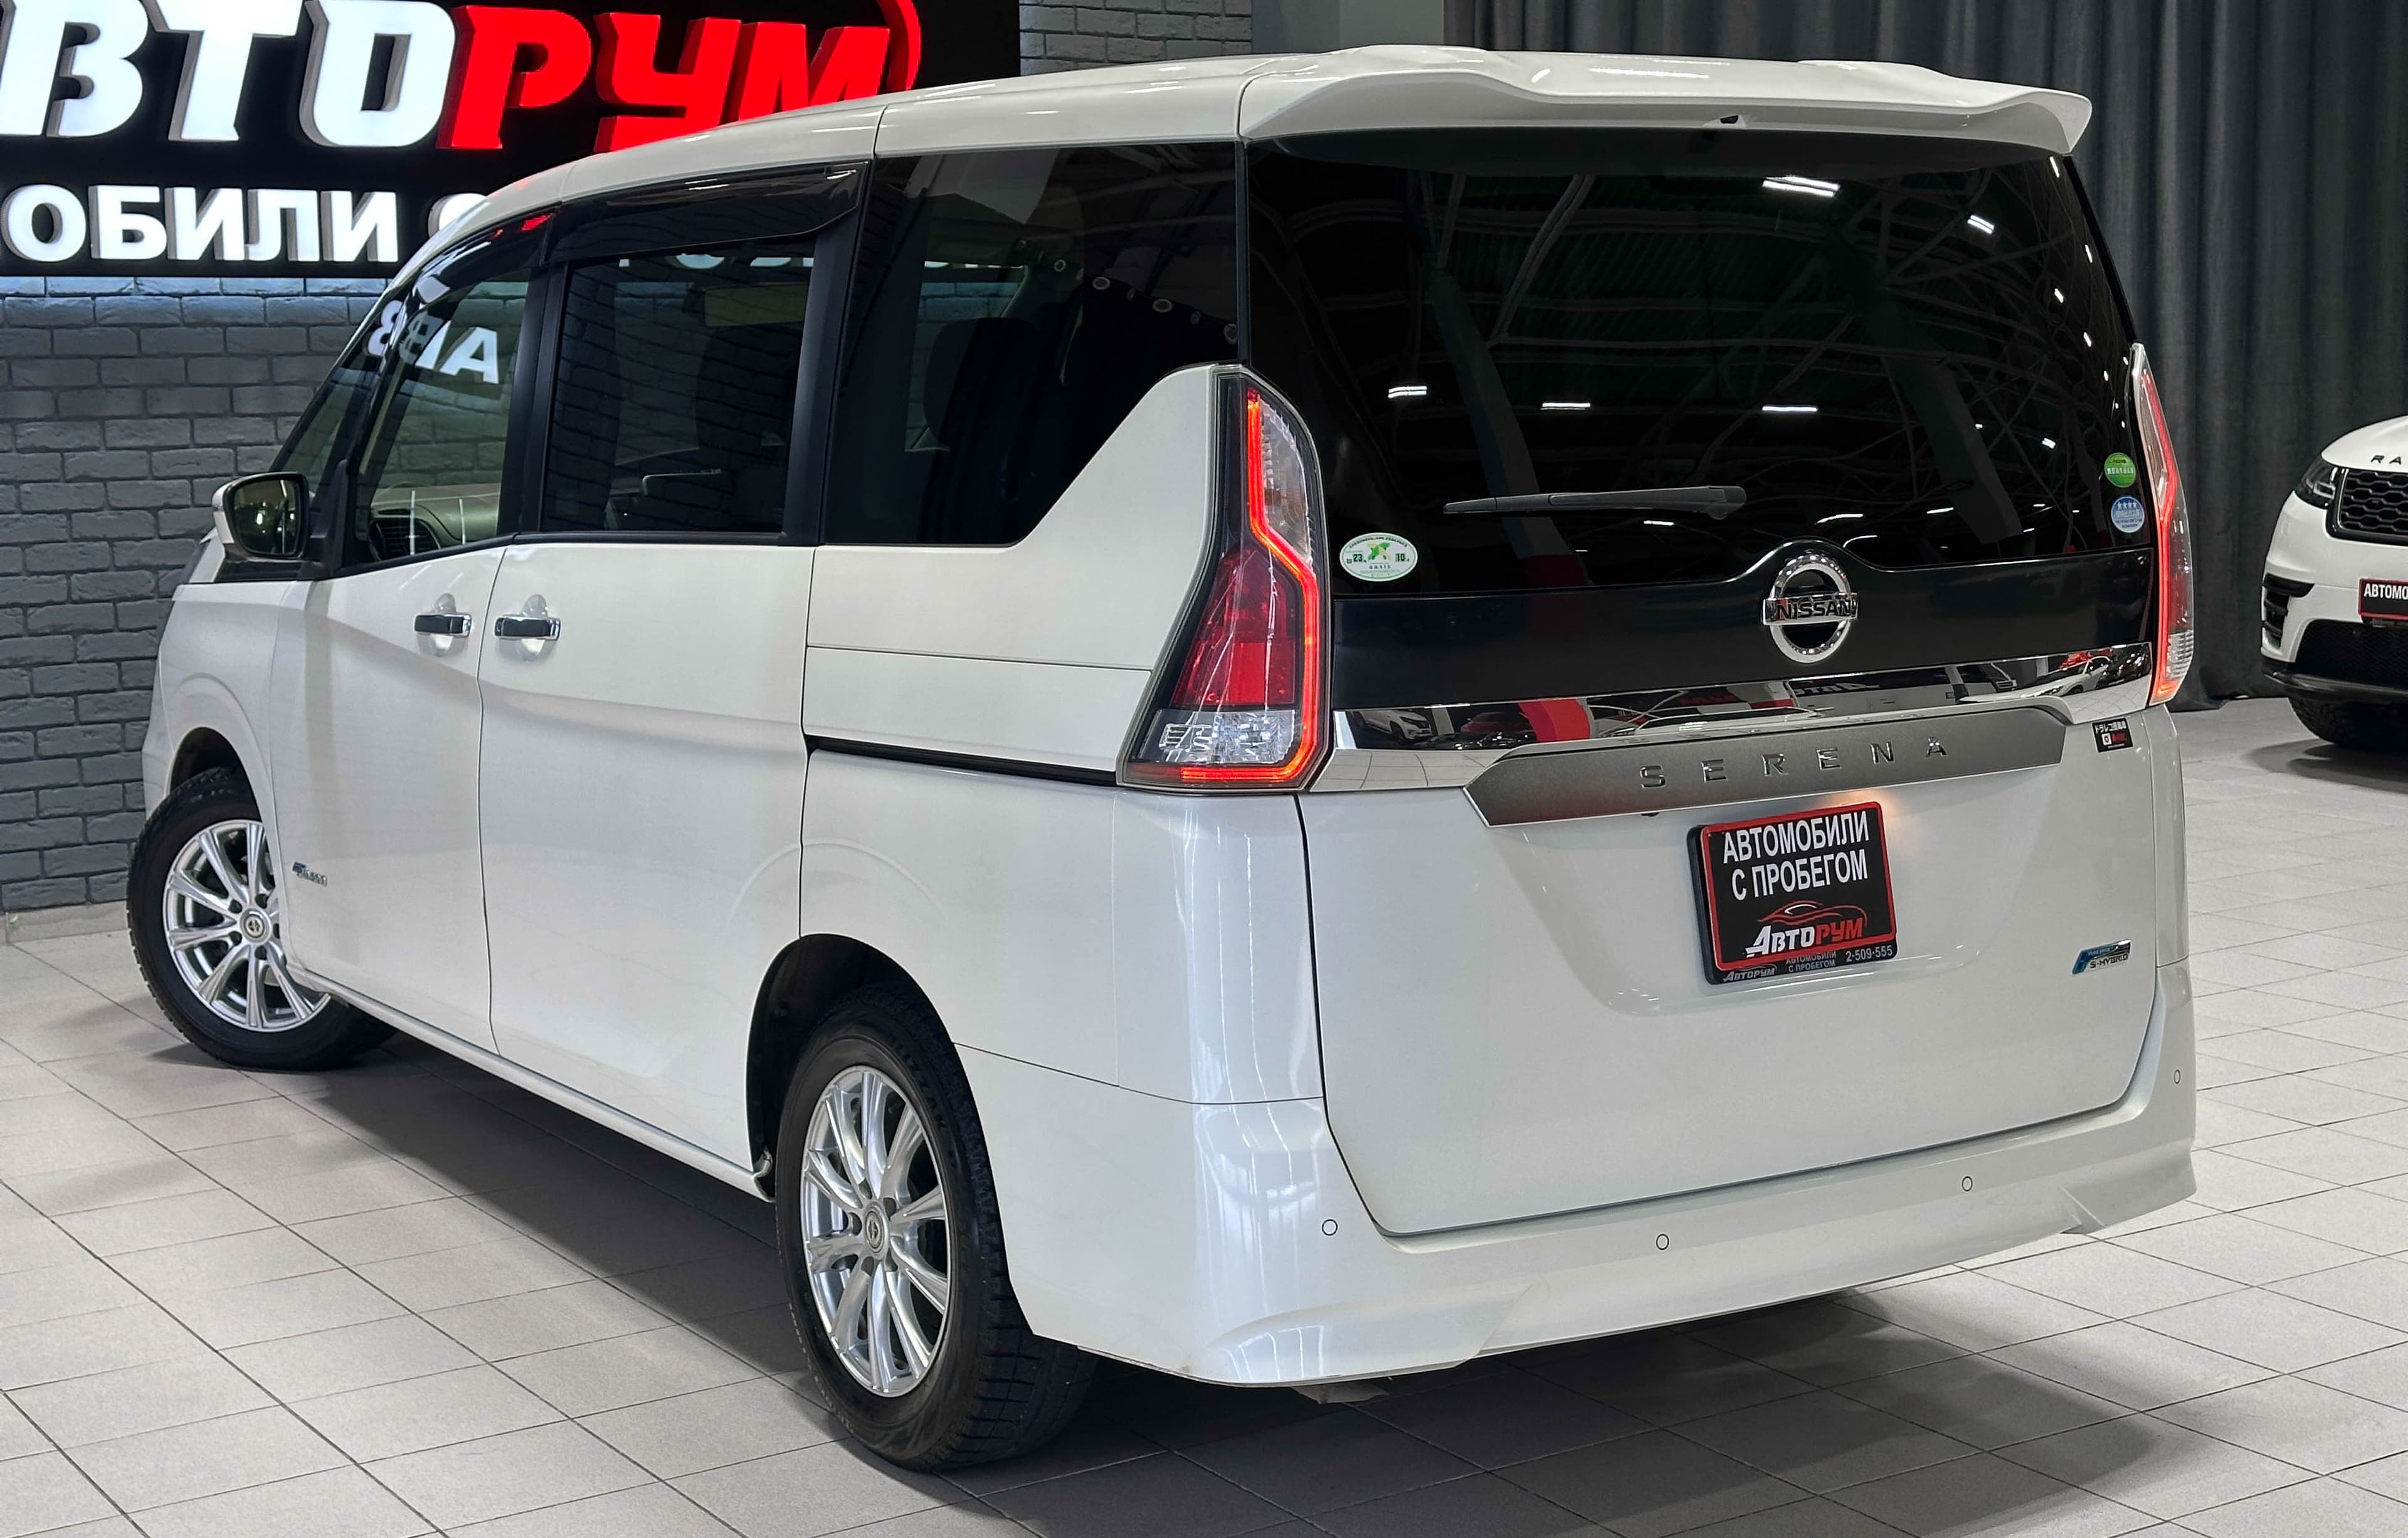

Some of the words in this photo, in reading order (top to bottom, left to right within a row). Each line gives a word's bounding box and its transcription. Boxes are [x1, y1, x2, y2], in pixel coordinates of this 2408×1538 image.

[3, 184, 399, 262] ОБИЛИ
[1777, 598, 1854, 621] NISSAN
[2363, 583, 2408, 600] АВТОМО
[1639, 737, 1947, 789] SERENA
[1723, 811, 1869, 864] АВТОМОБИЛИ
[1731, 868, 1747, 900] С
[1751, 849, 1868, 897] ПРОБЕГОМ
[1795, 959, 1836, 971] ПРОБЕГОМ
